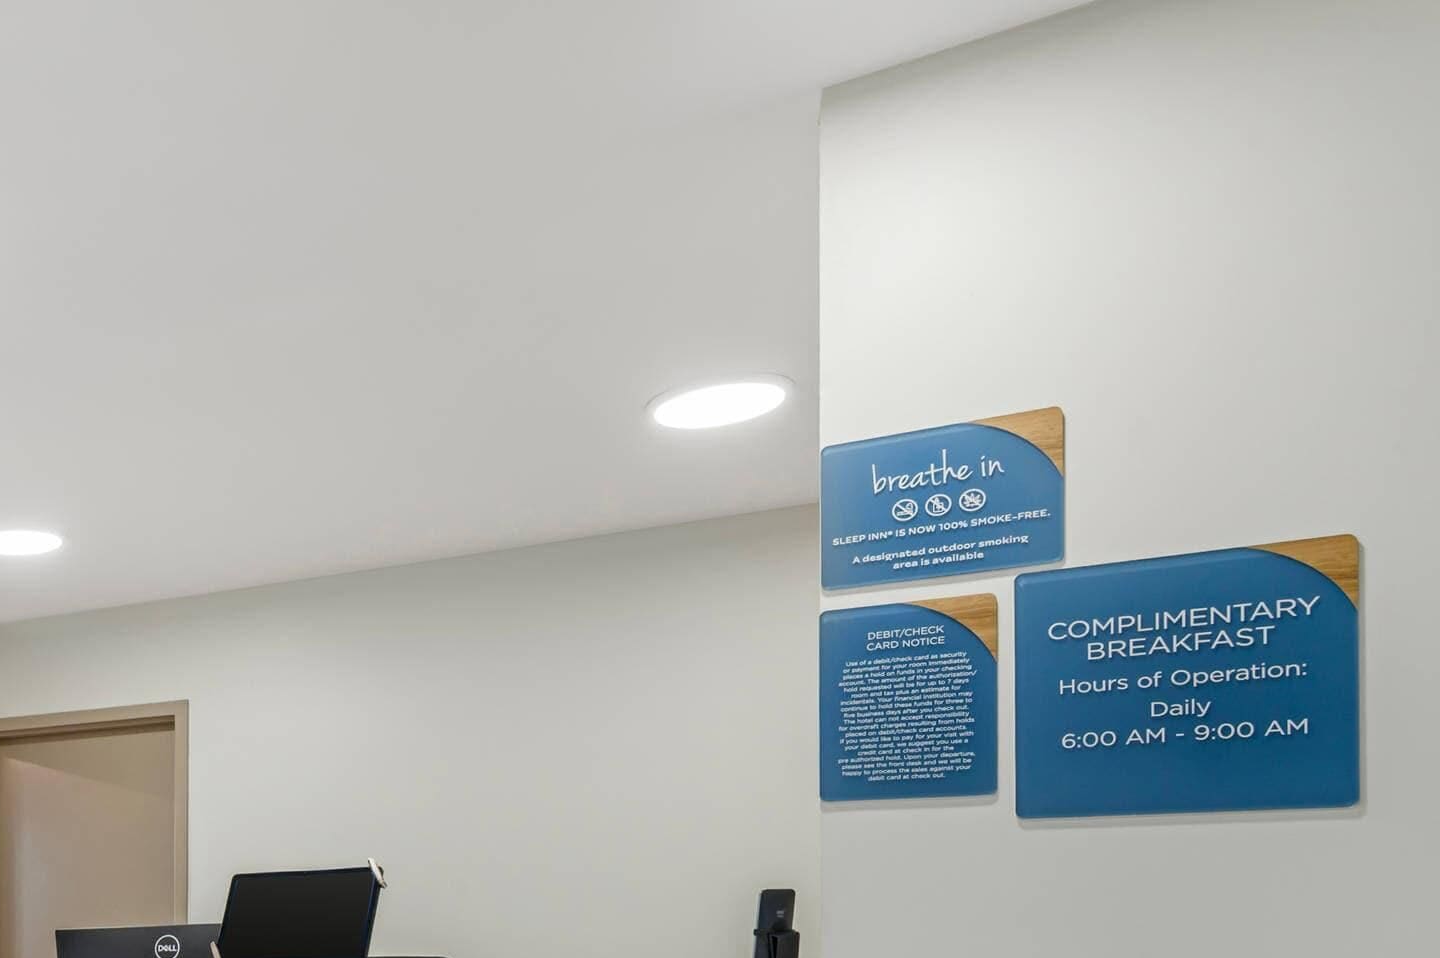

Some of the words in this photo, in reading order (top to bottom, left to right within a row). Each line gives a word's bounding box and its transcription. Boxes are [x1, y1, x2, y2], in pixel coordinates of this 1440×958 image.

[872, 449, 973, 495] breathe
[980, 456, 1004, 477] in
[832, 534, 866, 546] SLEEP
[896, 528, 906, 536] IS
[909, 524, 936, 535] NOW
[939, 520, 968, 530] 100%
[971, 509, 1051, 527] SMOKE-FREE.
[852, 556, 860, 564] A
[863, 547, 925, 562] designated
[928, 542, 976, 553] outdoor
[978, 535, 1029, 548] smoking
[893, 560, 918, 569] area
[921, 558, 930, 566] is
[932, 552, 984, 565] available
[868, 624, 944, 640] DEBIT/CHECK
[1048, 596, 1320, 640] COMPLIMENTARY
[866, 641, 899, 651] CARD
[902, 636, 944, 648] NOTICE
[1087, 625, 1275, 660] BREAKFAST
[1059, 677, 1128, 695] Hours
[1138, 671, 1162, 689] of
[1171, 662, 1307, 692] Operation:
[1151, 700, 1211, 718] Daily
[1062, 731, 1116, 749] 6:00
[1126, 728, 1166, 745] AM
[1194, 723, 1254, 741] 9:00
[1264, 718, 1310, 736] AM
[158, 944, 176, 952] DELL
